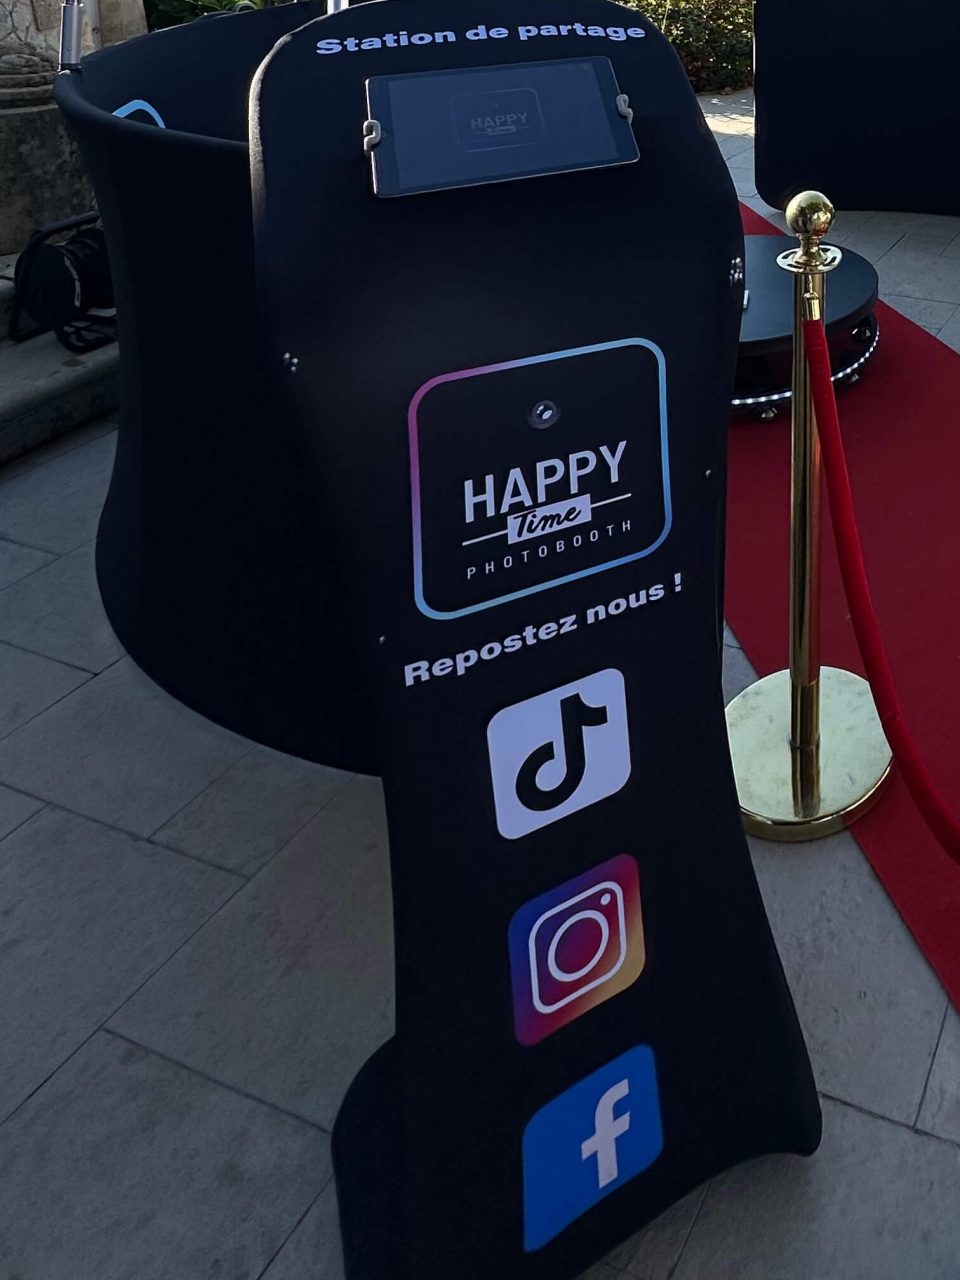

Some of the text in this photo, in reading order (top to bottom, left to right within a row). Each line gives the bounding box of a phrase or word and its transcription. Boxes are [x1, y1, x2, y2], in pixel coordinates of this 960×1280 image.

[316, 22, 646, 54] Station de partage
[470, 112, 527, 129] HAPPY
[464, 440, 627, 523] HAPPY
[513, 506, 582, 539] Time
[467, 520, 632, 580] PHOTOBOOTH
[404, 614, 578, 687] Repostez
[586, 582, 666, 624] nous
